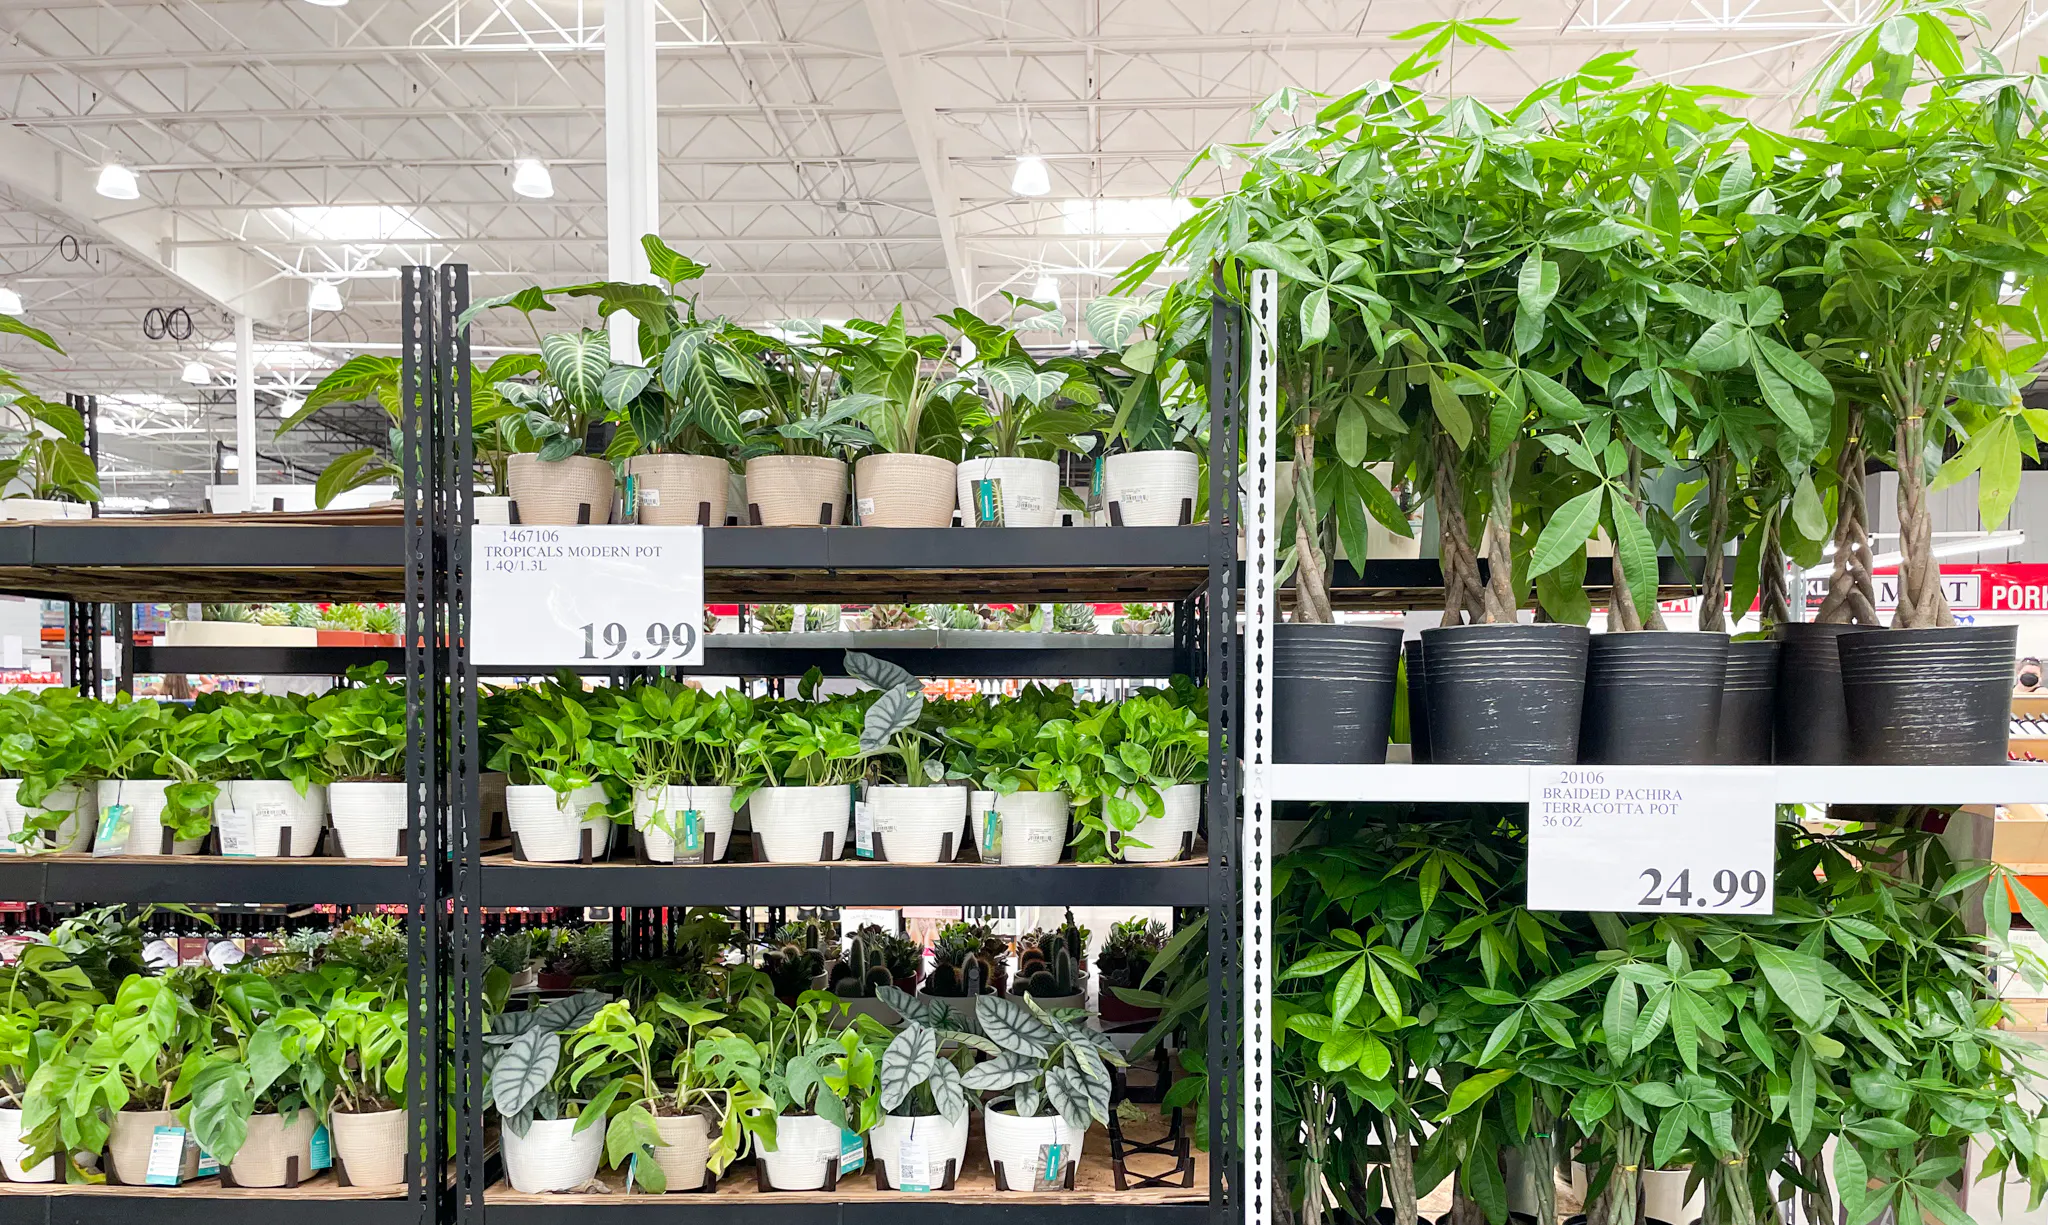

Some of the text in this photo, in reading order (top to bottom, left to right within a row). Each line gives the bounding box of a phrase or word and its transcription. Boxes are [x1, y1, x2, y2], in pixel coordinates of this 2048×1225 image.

[502, 530, 559, 542] 1467106
[484, 546, 663, 557] TROPICALS MODERN POT
[484, 560, 547, 572] 1.4Q/1.3L
[578, 622, 697, 660] 19.99
[1560, 771, 1604, 784] 20106
[1543, 788, 1683, 801] BRAIDED PACHIRA
[1542, 802, 1679, 815] TERRACOTTA POT
[1542, 816, 1583, 827] 36 OZ
[1637, 867, 1767, 908] 24.99
